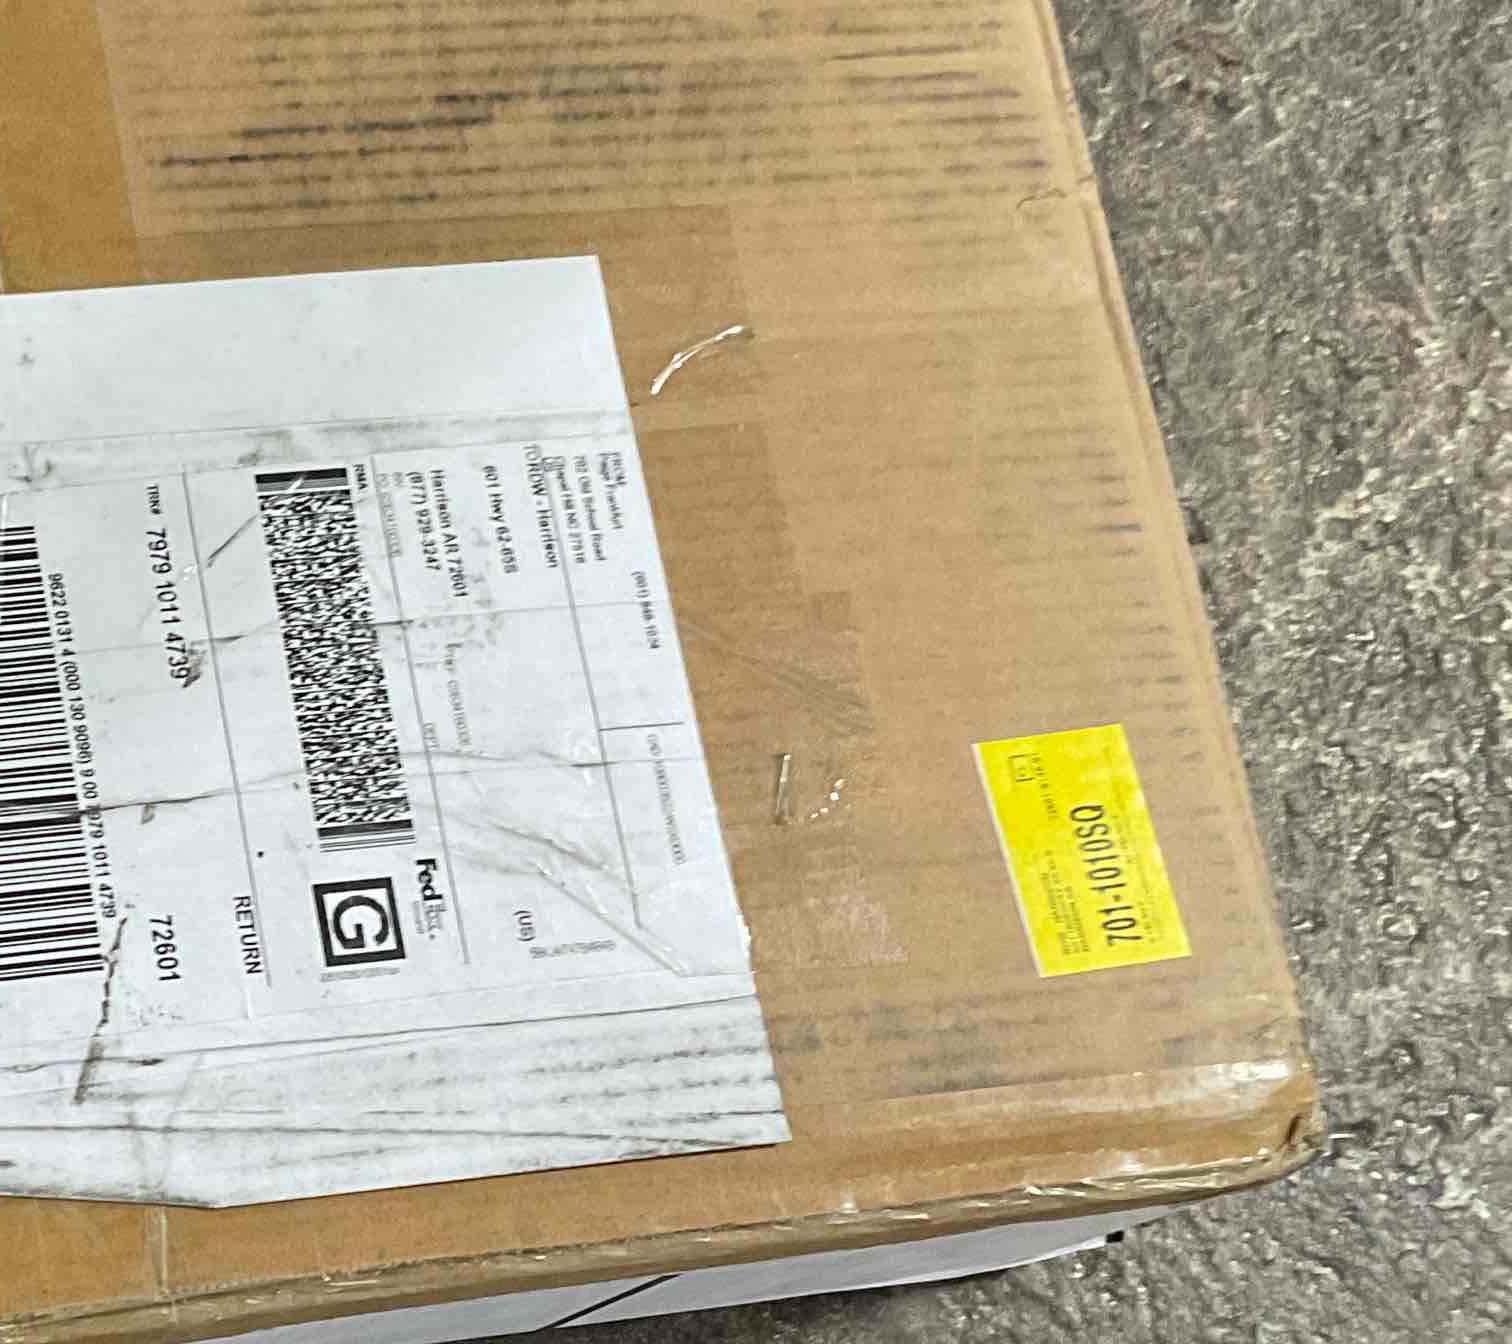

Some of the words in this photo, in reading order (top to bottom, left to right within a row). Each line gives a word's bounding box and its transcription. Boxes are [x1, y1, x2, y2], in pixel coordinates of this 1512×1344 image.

[526, 463, 547, 496] RDW
[429, 469, 453, 529] Harrison
[488, 494, 505, 523] Hwy
[146, 527, 173, 573] 7979
[442, 532, 460, 555] AR
[536, 509, 559, 568] Harrison
[48, 573, 66, 606] 9622
[447, 558, 469, 597] 72601
[156, 581, 182, 625] 1011
[55, 609, 73, 642] 0131
[61, 646, 76, 657] 4
[164, 631, 190, 681] 4739
[59, 659, 80, 691] (000
[69, 695, 85, 719] 130
[73, 723, 93, 764] 9096)
[80, 768, 93, 779] 9
[82, 781, 98, 800] 00
[91, 844, 111, 879] 1011
[1069, 804, 1143, 946] 701-1010SQ
[96, 883, 117, 918] 4739
[232, 894, 264, 975] RETURN
[333, 895, 389, 949] G
[513, 909, 536, 942] (US)
[149, 914, 182, 984] 72601
